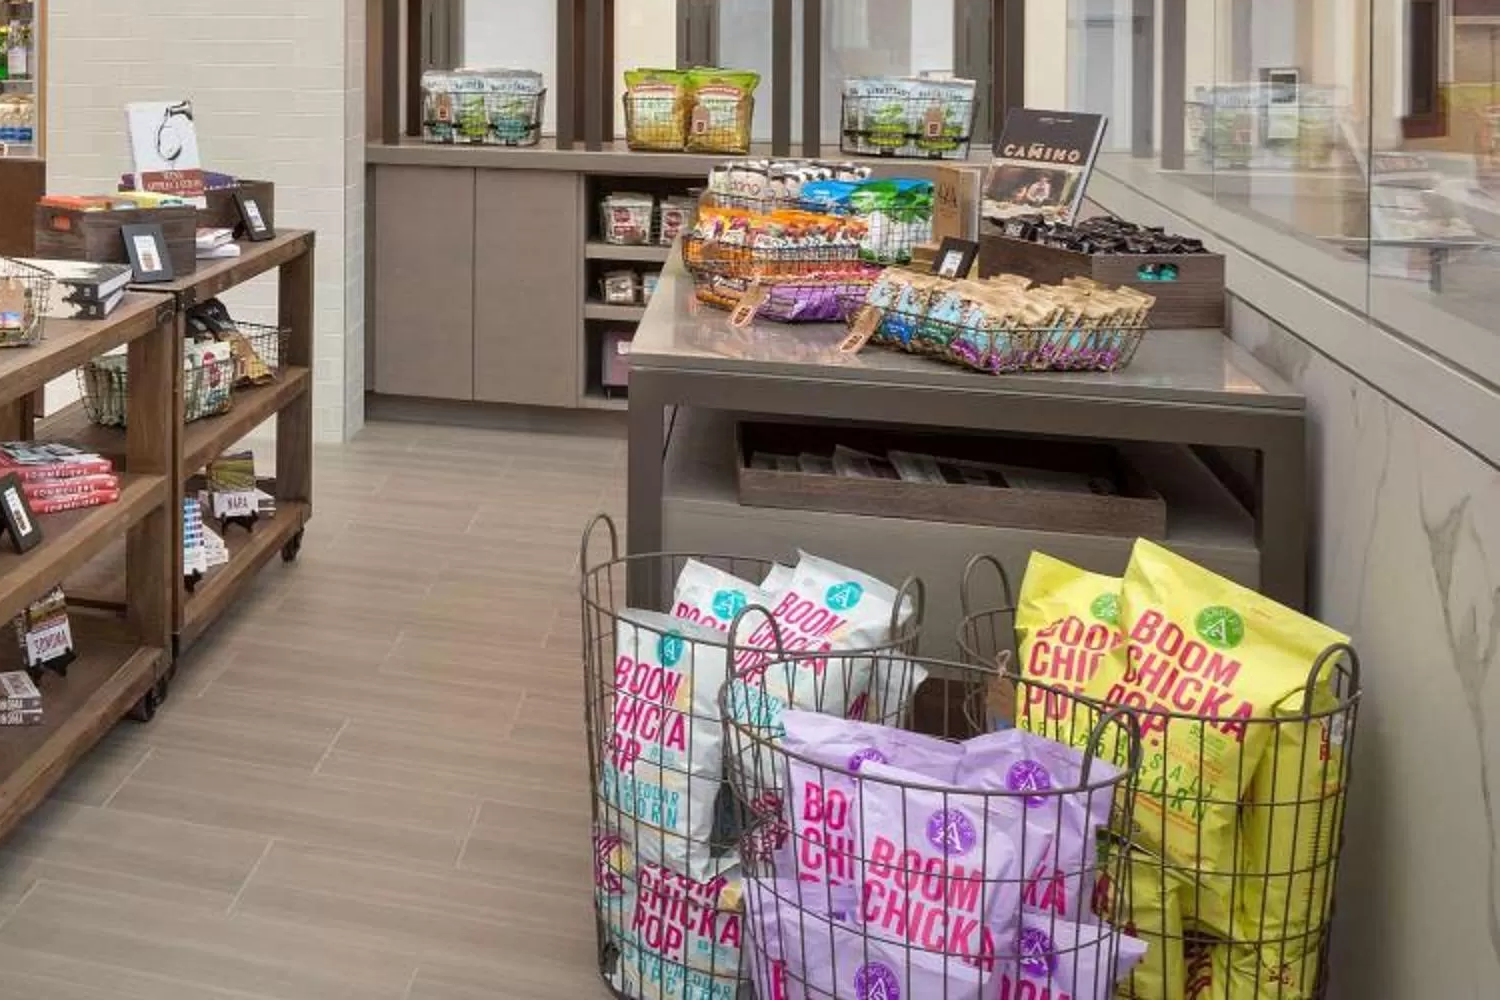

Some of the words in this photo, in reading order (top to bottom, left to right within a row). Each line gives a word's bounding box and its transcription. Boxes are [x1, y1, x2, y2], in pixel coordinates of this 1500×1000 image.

[1130, 609, 1241, 687] BOOM
[1123, 645, 1255, 742] CHICKA
[867, 836, 983, 913] BOOM
[861, 879, 995, 972] CHICKA
